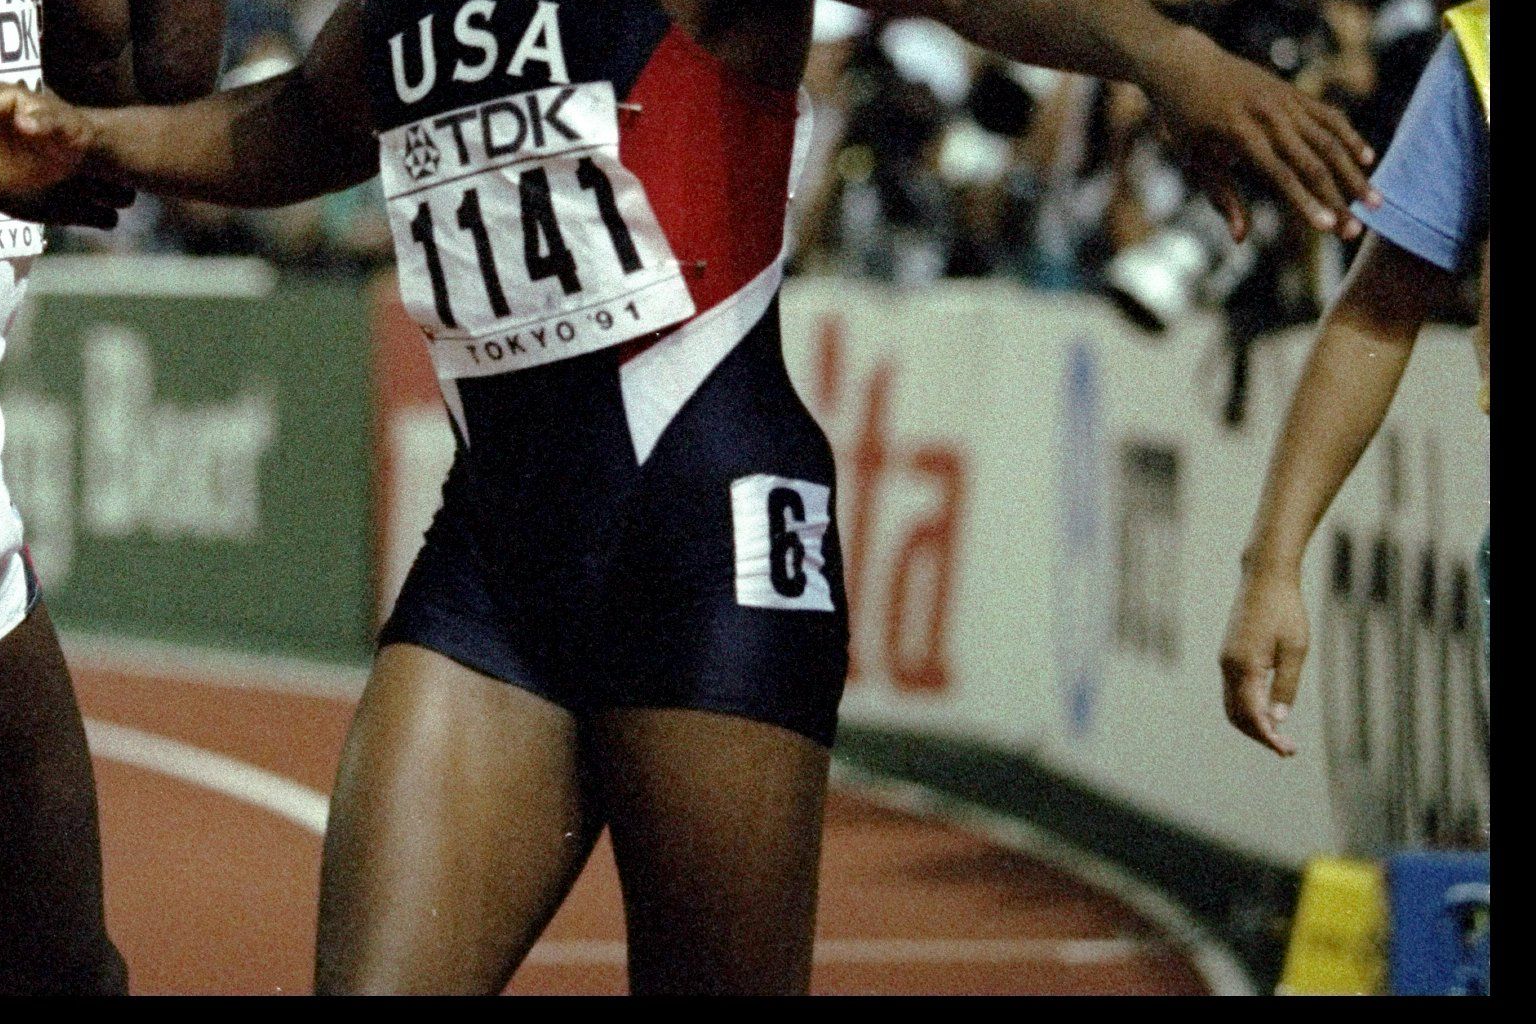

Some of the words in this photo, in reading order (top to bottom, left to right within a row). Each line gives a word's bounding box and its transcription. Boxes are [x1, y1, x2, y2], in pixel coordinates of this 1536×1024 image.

[436, 88, 583, 168] TDK
[409, 155, 644, 331] 1141
[467, 319, 576, 364] TOKYO
[767, 487, 806, 598] 6
